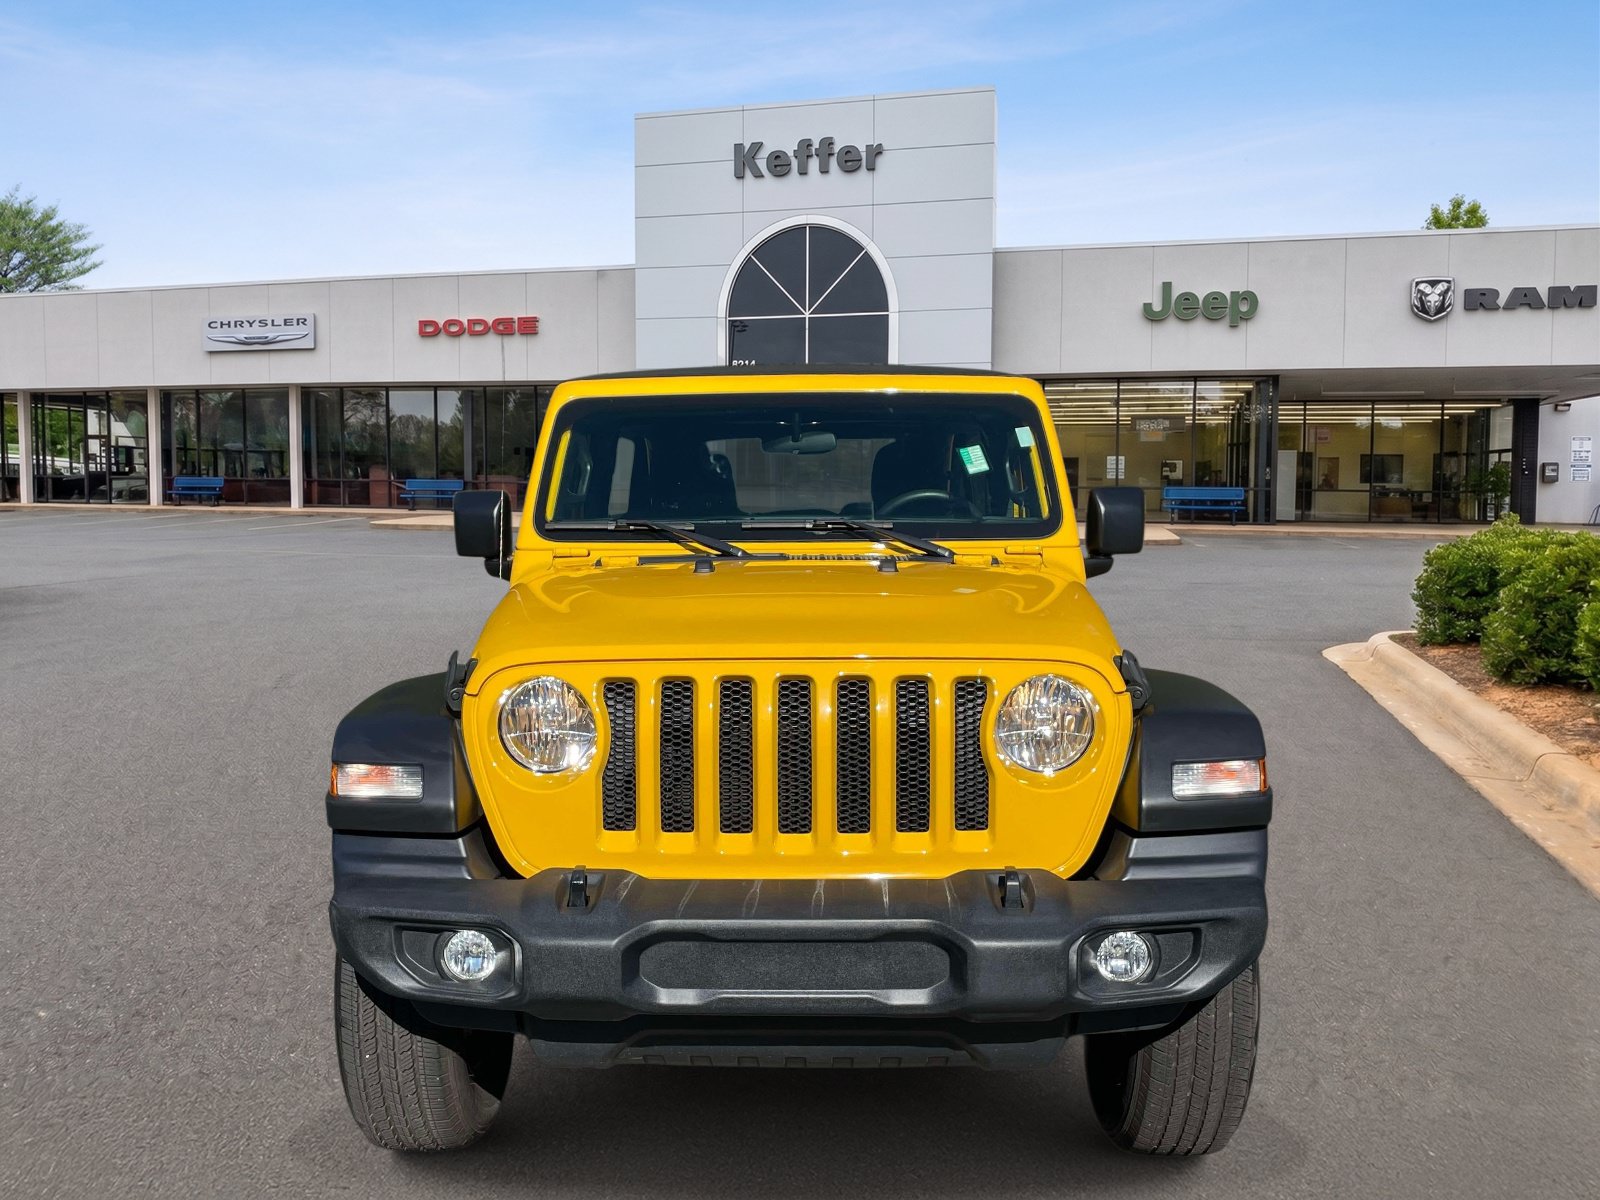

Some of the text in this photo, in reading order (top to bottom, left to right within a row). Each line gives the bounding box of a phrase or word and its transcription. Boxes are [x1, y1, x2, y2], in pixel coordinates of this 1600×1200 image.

[734, 137, 883, 178] Keffer
[1143, 281, 1258, 327] Jeep
[1464, 285, 1597, 310] RAM
[208, 318, 308, 329] CHRYSLER
[418, 317, 539, 336] DODGE
